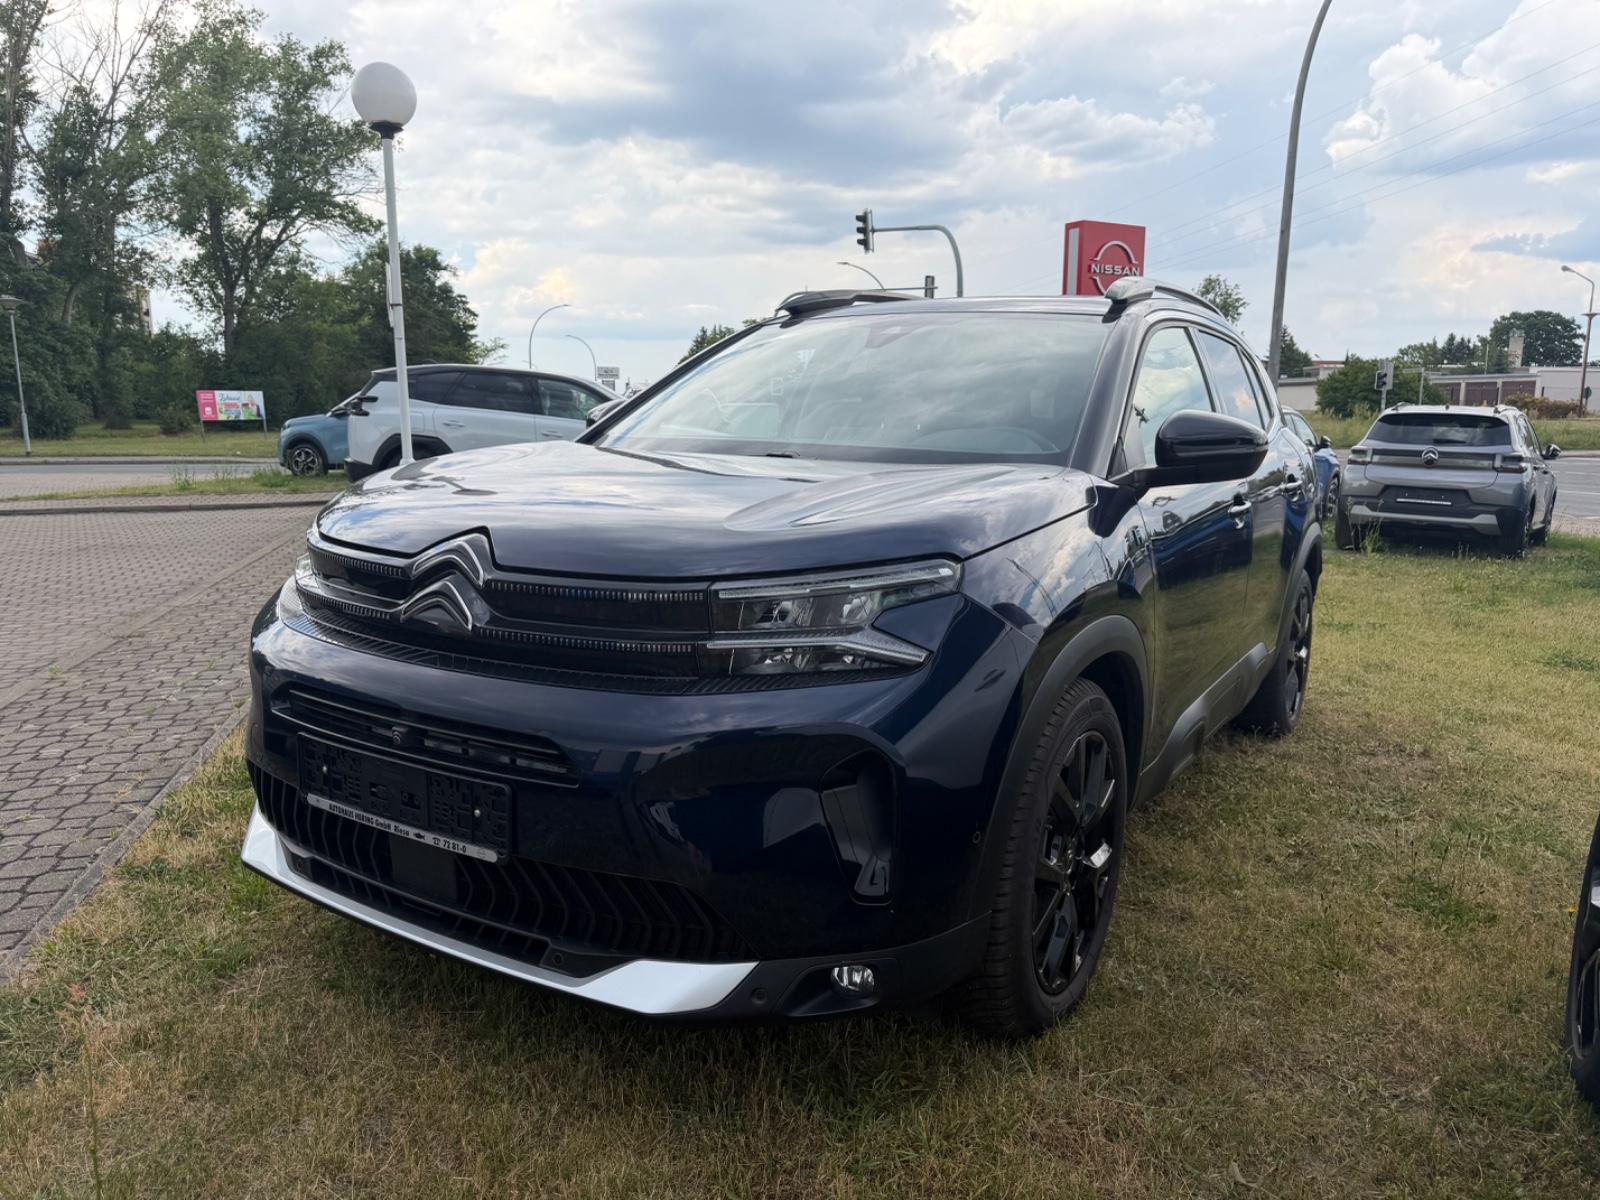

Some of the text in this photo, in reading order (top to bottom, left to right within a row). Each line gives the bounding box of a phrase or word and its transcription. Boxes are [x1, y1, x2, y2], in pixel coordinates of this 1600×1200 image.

[1090, 263, 1140, 276] NISSAN
[329, 803, 354, 818] AUTOHAUS
[375, 818, 392, 830] GmbH
